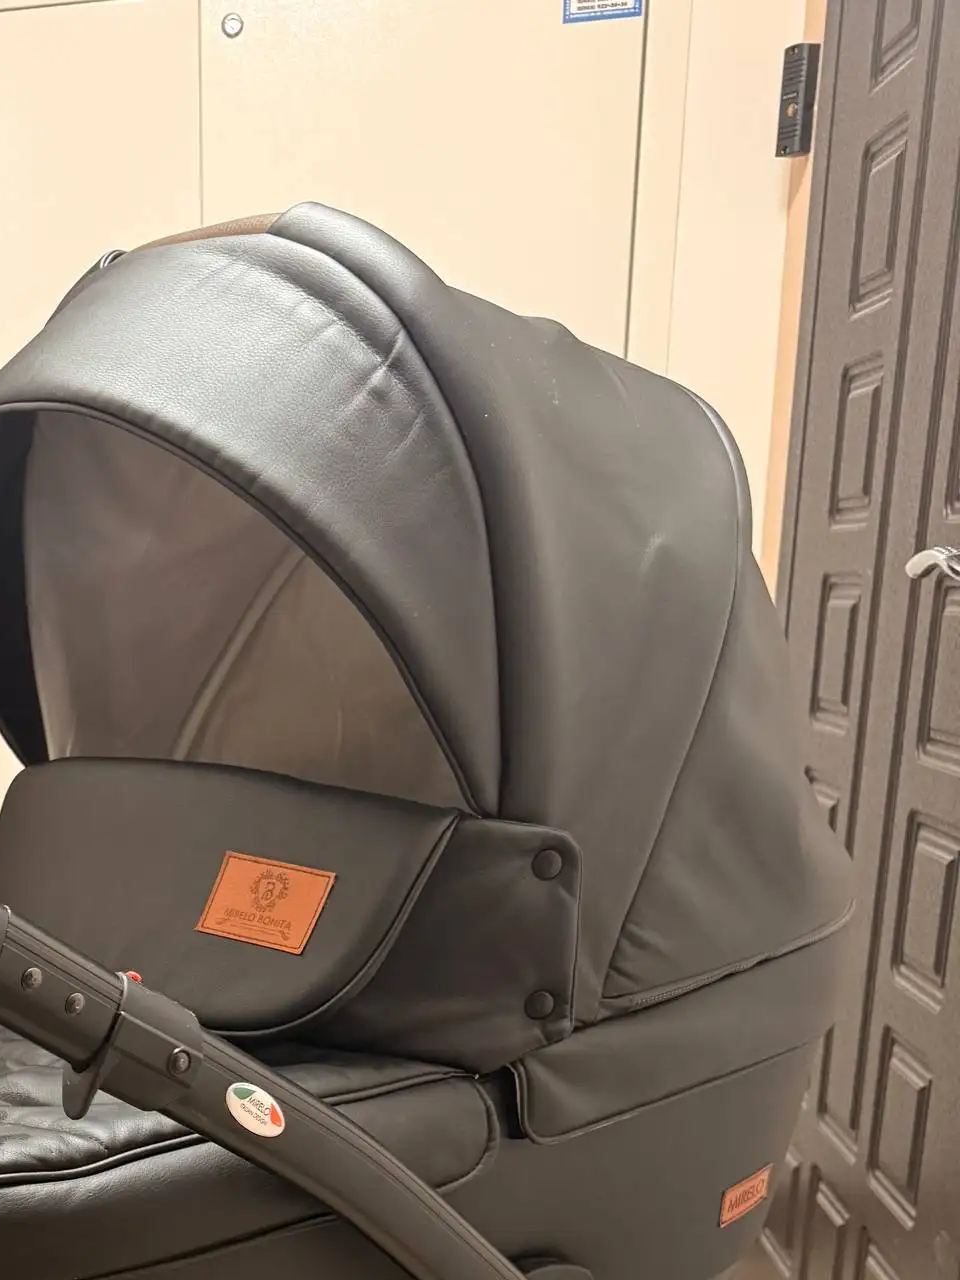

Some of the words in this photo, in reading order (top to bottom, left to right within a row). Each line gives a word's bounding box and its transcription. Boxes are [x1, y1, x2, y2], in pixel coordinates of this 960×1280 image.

[223, 907, 257, 923] MIRELO
[257, 914, 293, 930] BONITA
[246, 1096, 271, 1116] MIRELO
[727, 1178, 765, 1213] MIRELO
